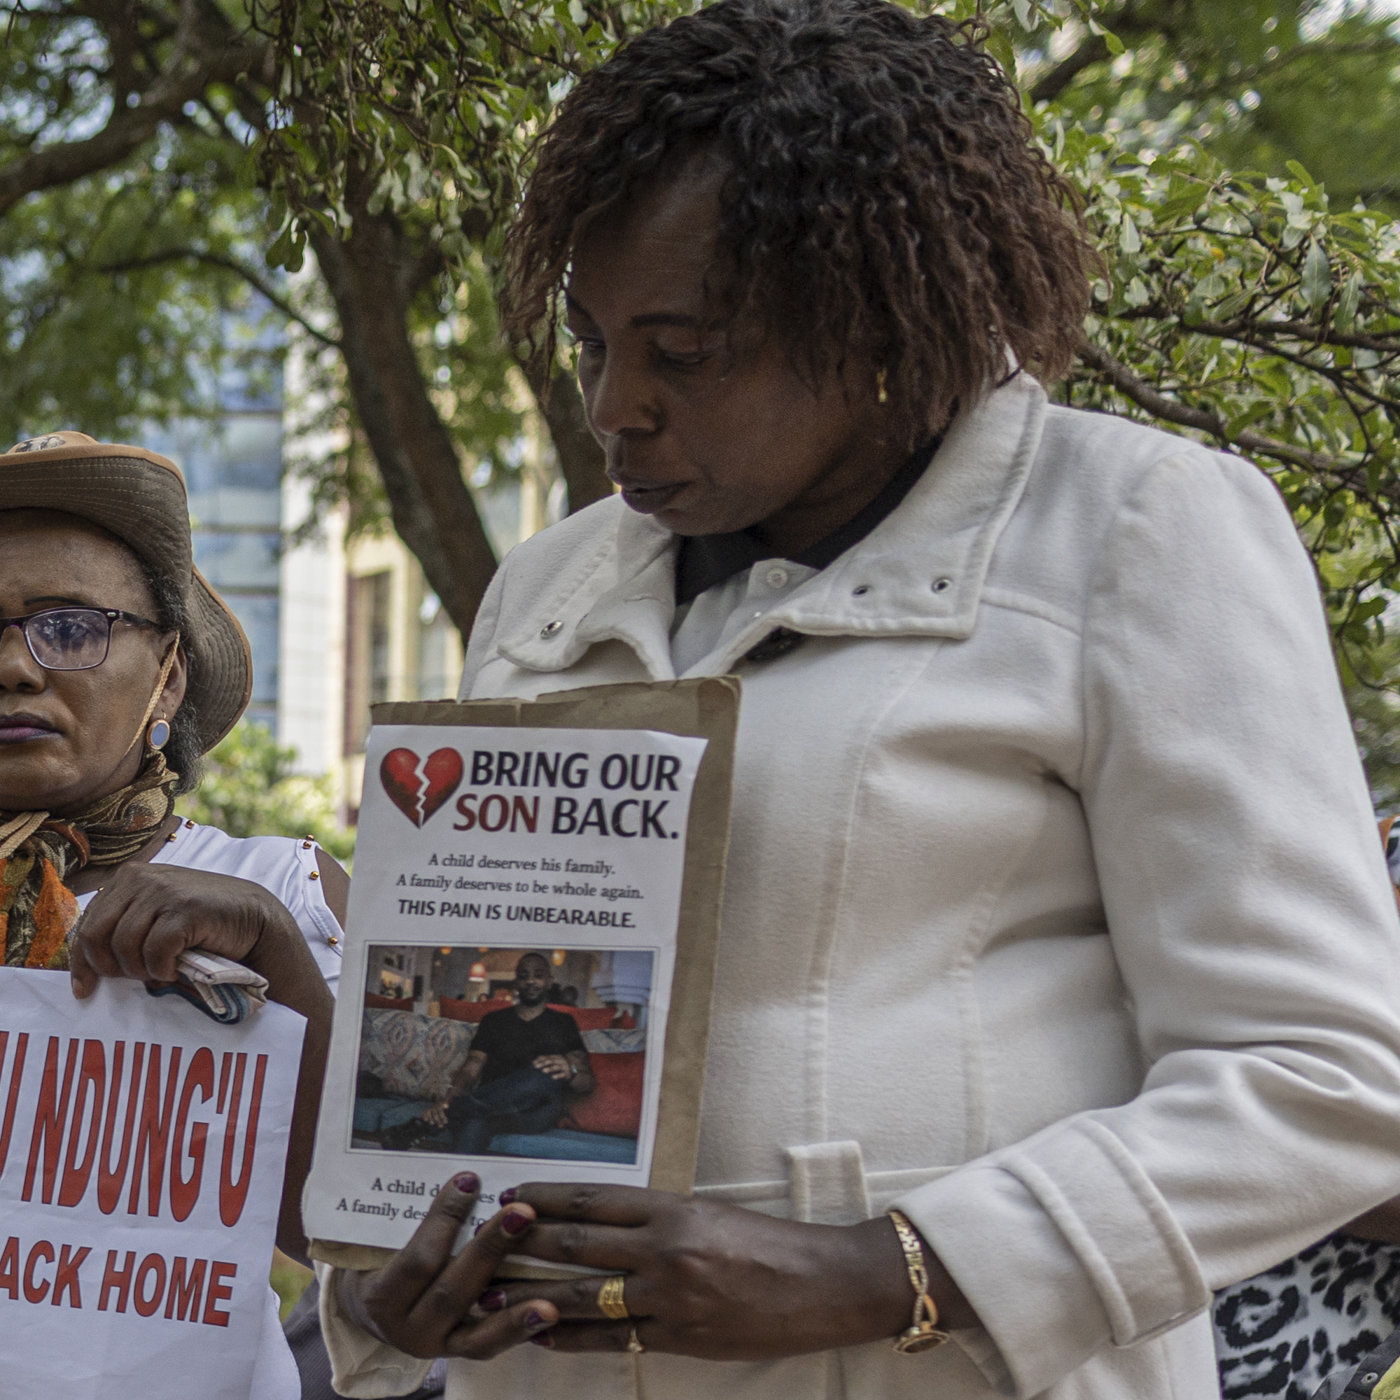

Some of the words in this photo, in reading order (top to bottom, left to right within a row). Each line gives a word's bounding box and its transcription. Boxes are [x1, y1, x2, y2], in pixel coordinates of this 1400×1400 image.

[471, 751, 588, 788] BRING
[601, 754, 680, 791] OUR
[453, 794, 539, 833] SON
[552, 797, 678, 839] BACK.
[428, 853, 439, 866] A
[442, 854, 474, 867] child
[478, 855, 536, 870] deserves
[541, 858, 561, 871] his
[565, 859, 615, 878] family.
[395, 873, 407, 887] A
[410, 874, 451, 891] family
[455, 877, 511, 891] deserves
[516, 882, 529, 892] to
[533, 880, 548, 893] be
[553, 882, 597, 896] whole
[601, 888, 643, 901] again.
[399, 899, 435, 916] THIS
[440, 902, 480, 918] PAIN
[486, 905, 501, 920] IS
[507, 906, 635, 928] UNBEARABLE.
[21, 1036, 268, 1227] NDUNG'U
[371, 1177, 383, 1192] A
[387, 1180, 425, 1195] child
[336, 1198, 348, 1212] A
[352, 1199, 399, 1220] family
[98, 1250, 237, 1327] HOME
